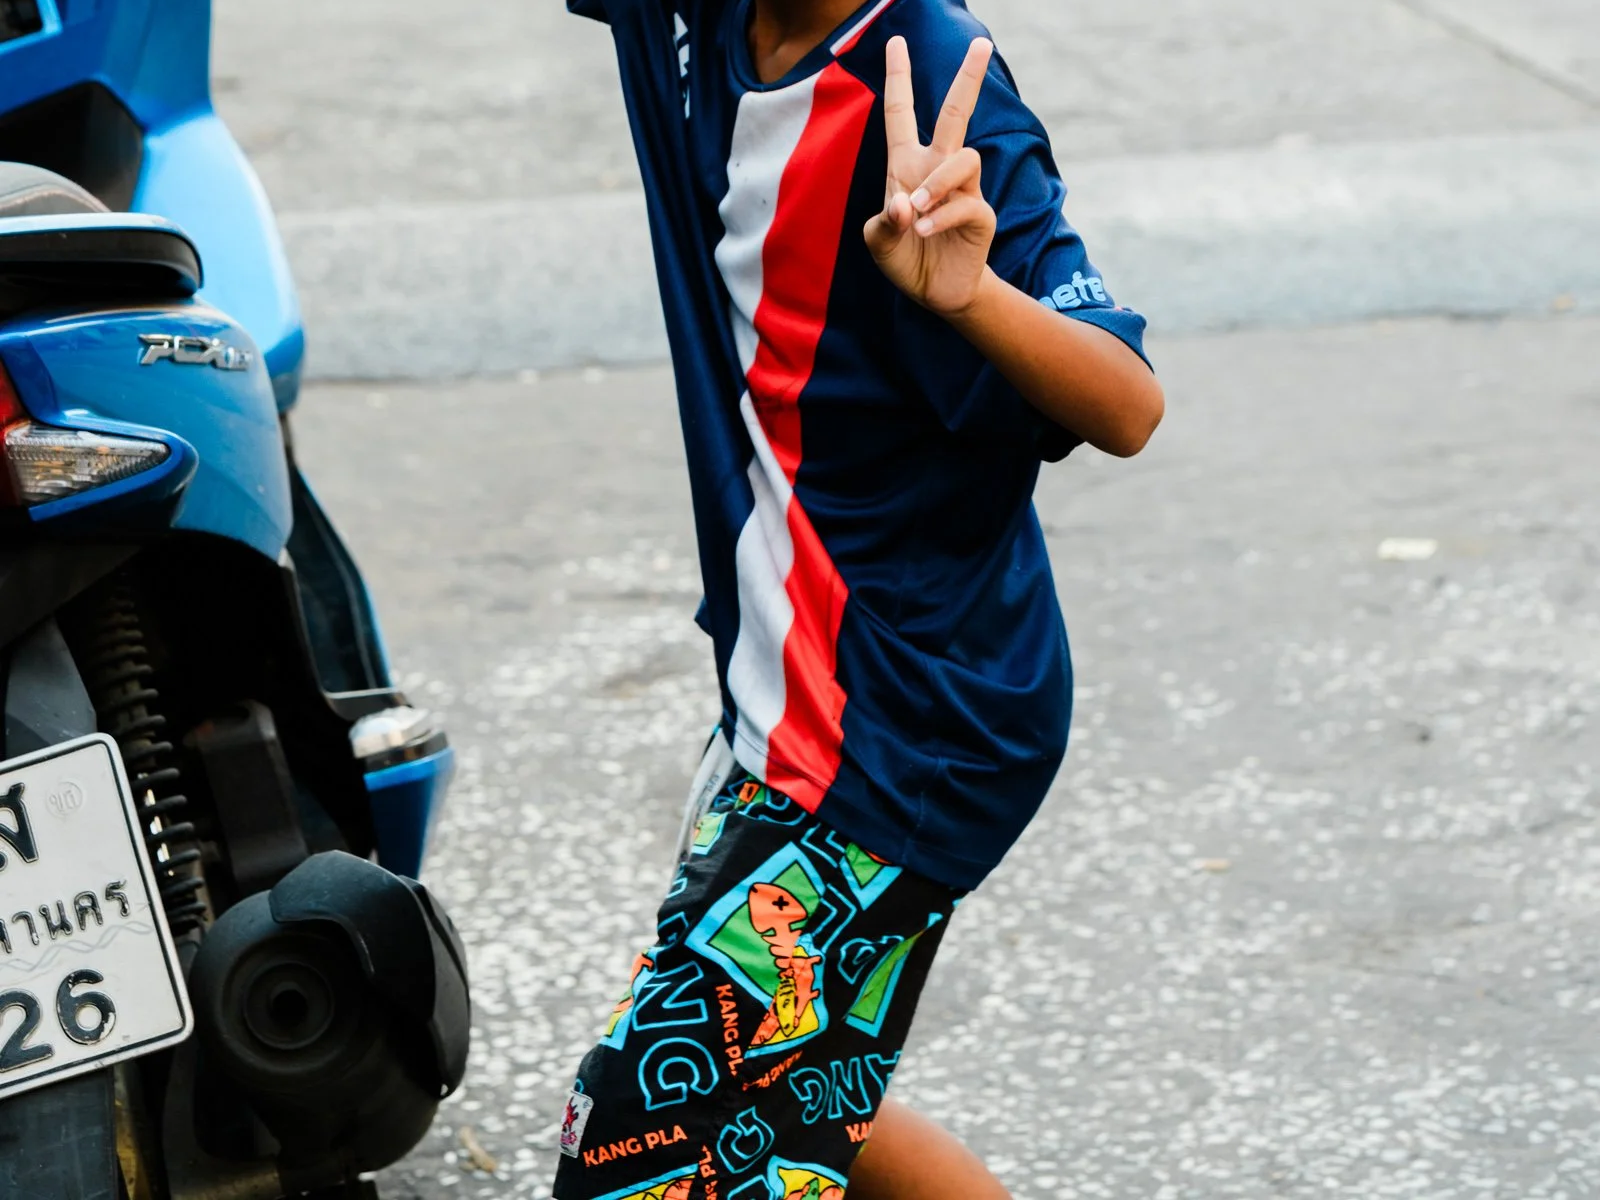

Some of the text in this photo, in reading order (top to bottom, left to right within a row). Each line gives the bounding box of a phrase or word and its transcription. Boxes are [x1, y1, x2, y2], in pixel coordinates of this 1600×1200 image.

[715, 983, 745, 1077] KANG PL
[583, 1124, 688, 1168] KANG PLA
